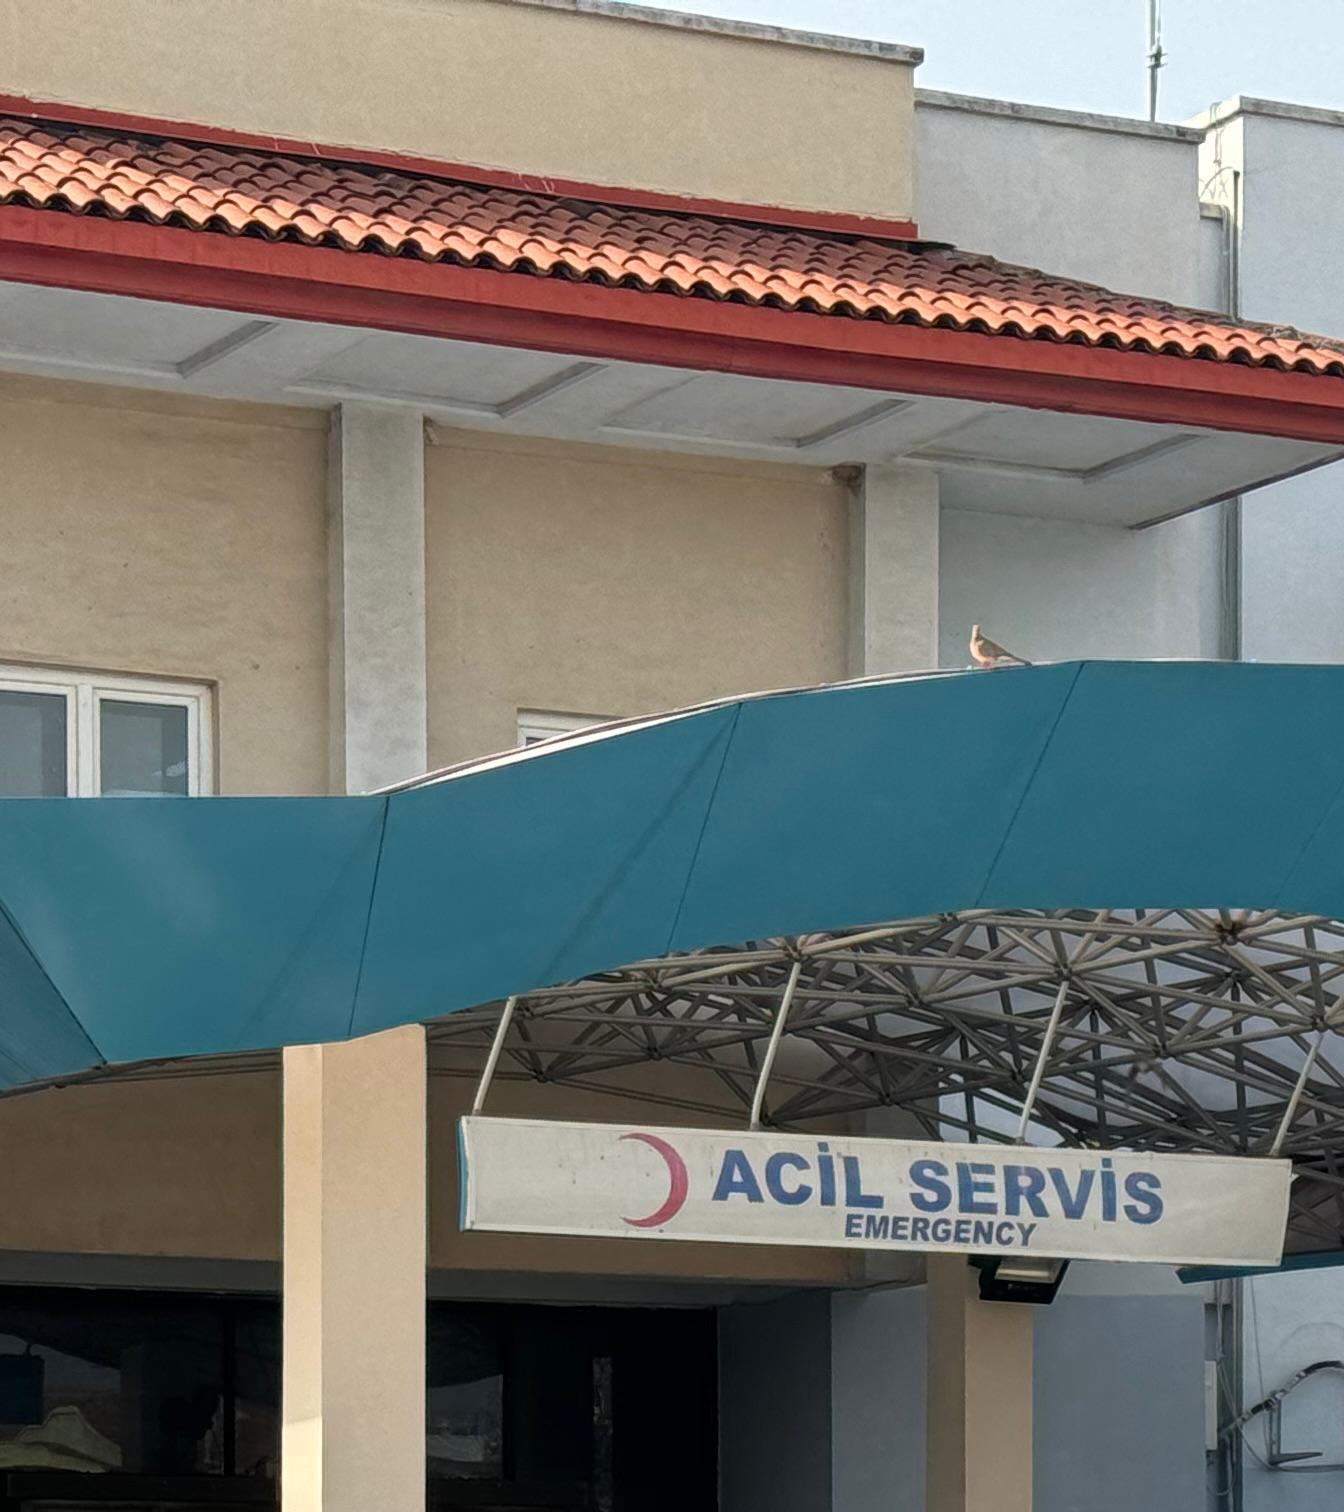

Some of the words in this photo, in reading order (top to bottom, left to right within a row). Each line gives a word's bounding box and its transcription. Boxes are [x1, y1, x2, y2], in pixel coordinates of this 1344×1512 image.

[711, 1141, 884, 1209] ACİL
[908, 1157, 1164, 1225] SERVİS
[844, 1213, 1037, 1247] EMERGENCY
